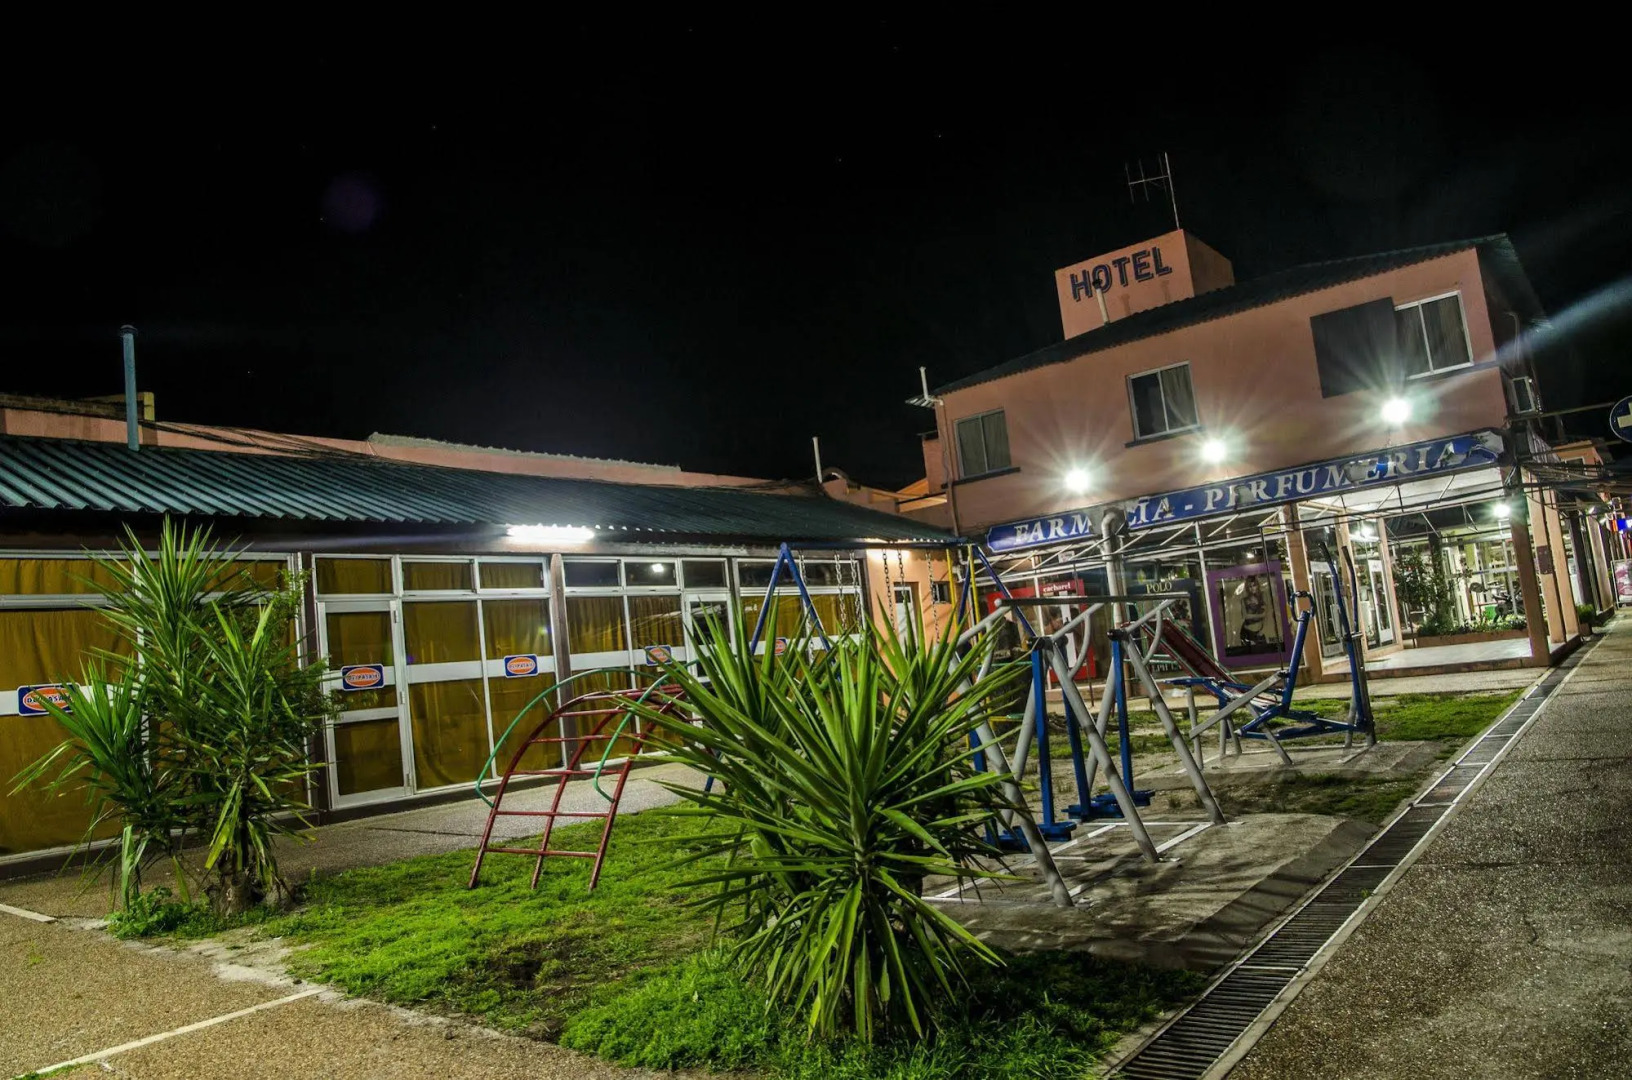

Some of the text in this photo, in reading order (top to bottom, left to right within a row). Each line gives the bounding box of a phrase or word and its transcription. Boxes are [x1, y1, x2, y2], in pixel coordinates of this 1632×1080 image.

[1070, 246, 1172, 302] HOTEL
[1043, 582, 1071, 592] cacharel
[1146, 581, 1172, 593] POLO
